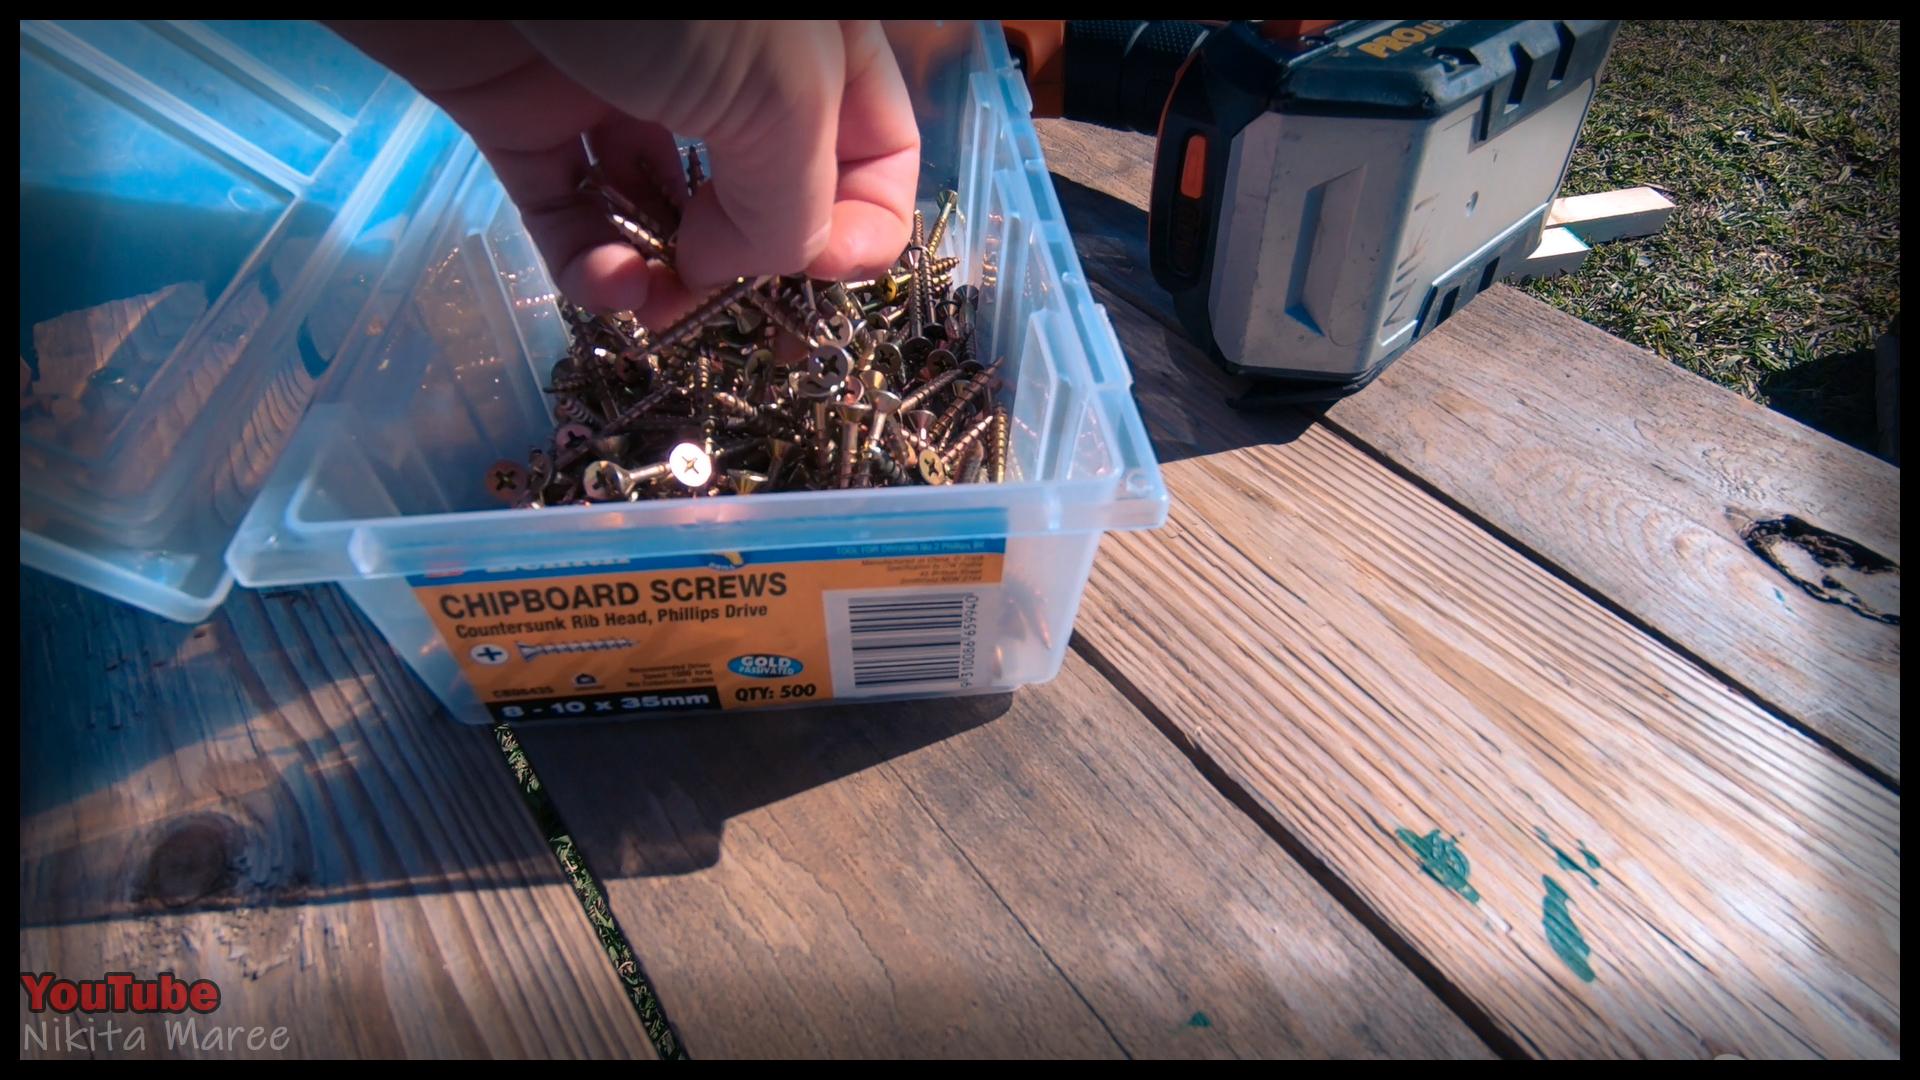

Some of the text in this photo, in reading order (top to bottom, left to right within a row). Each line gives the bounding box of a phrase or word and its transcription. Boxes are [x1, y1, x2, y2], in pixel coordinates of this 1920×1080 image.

[439, 572, 787, 619] CHIPBOARD SCREWS
[455, 604, 768, 639] Countersunk Rib Head, Phillips Drive
[740, 656, 792, 668] GOLD
[735, 683, 816, 702] QTY: 500
[502, 705, 524, 717] 8
[550, 701, 586, 714] 10
[593, 701, 613, 711] x
[620, 694, 710, 709] 35mm
